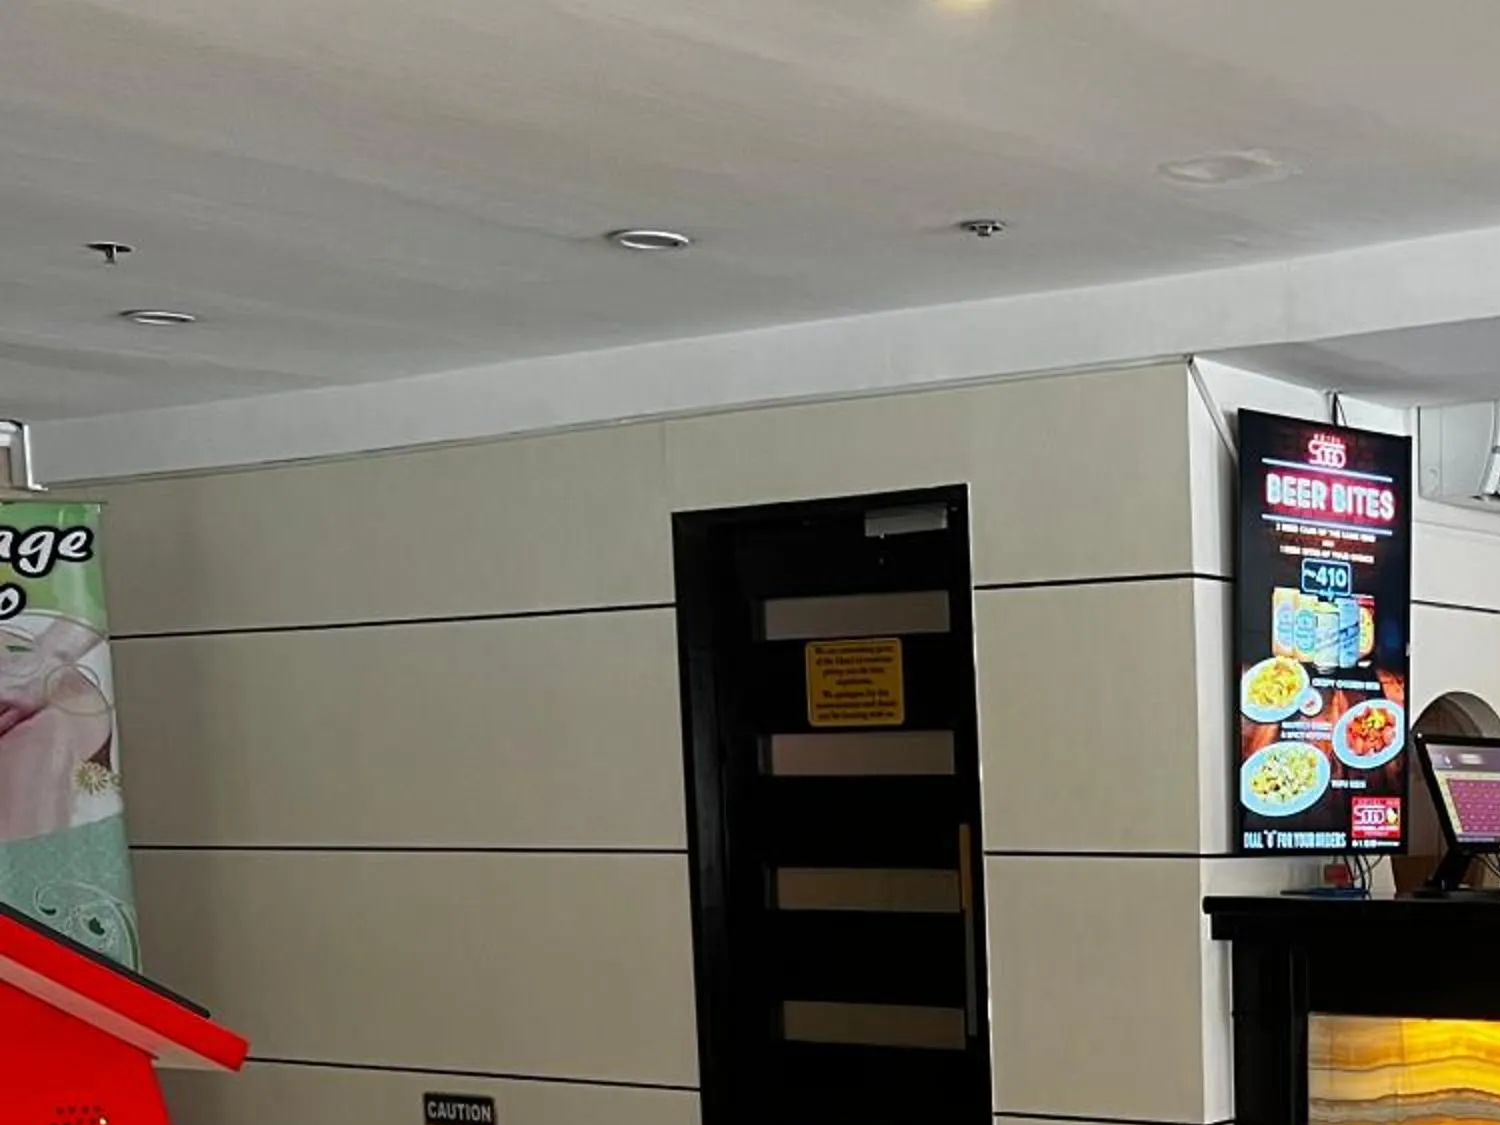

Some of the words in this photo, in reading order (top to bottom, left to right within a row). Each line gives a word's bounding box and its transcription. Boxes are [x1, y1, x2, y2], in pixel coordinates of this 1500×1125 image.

[1266, 473, 1327, 511] BEER
[1332, 484, 1395, 520] BITES
[427, 1100, 492, 1123] CAUTION
